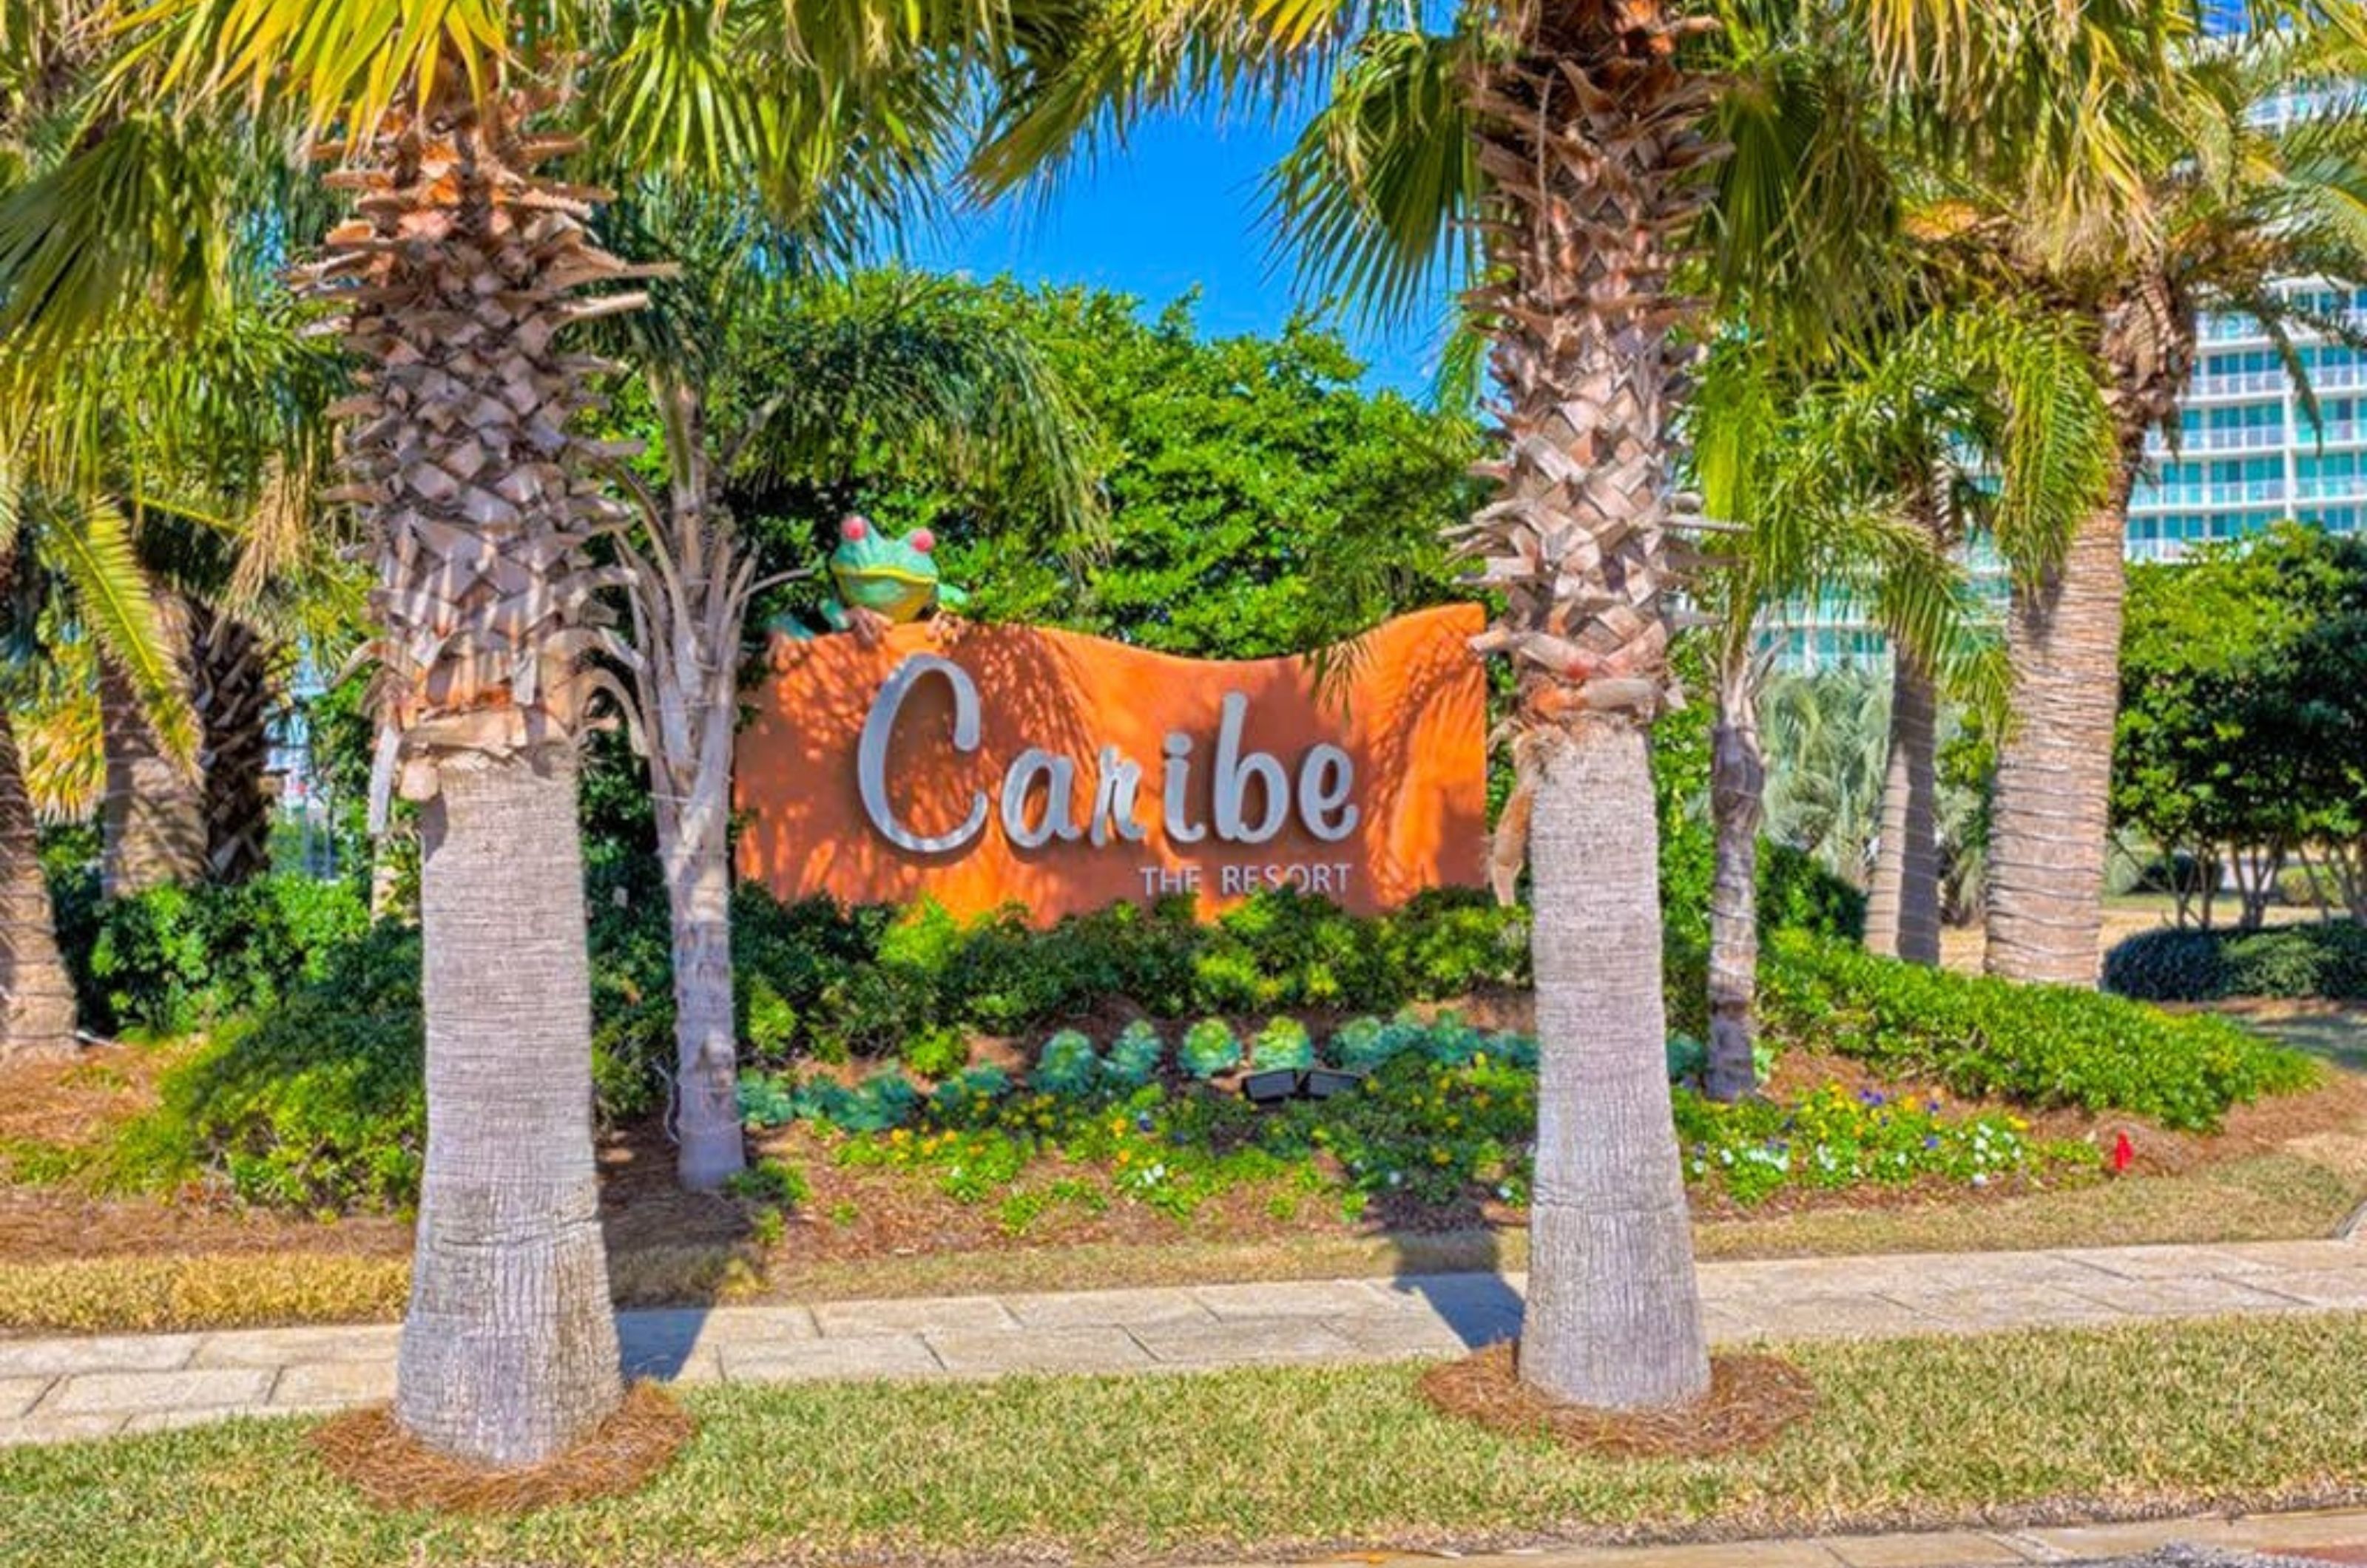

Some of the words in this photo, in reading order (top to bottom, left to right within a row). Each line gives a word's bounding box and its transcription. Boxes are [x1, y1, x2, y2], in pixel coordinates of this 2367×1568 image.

[857, 652, 1360, 854] Caribe
[1139, 865, 1202, 896] THE
[1220, 862, 1353, 895] RESORT
